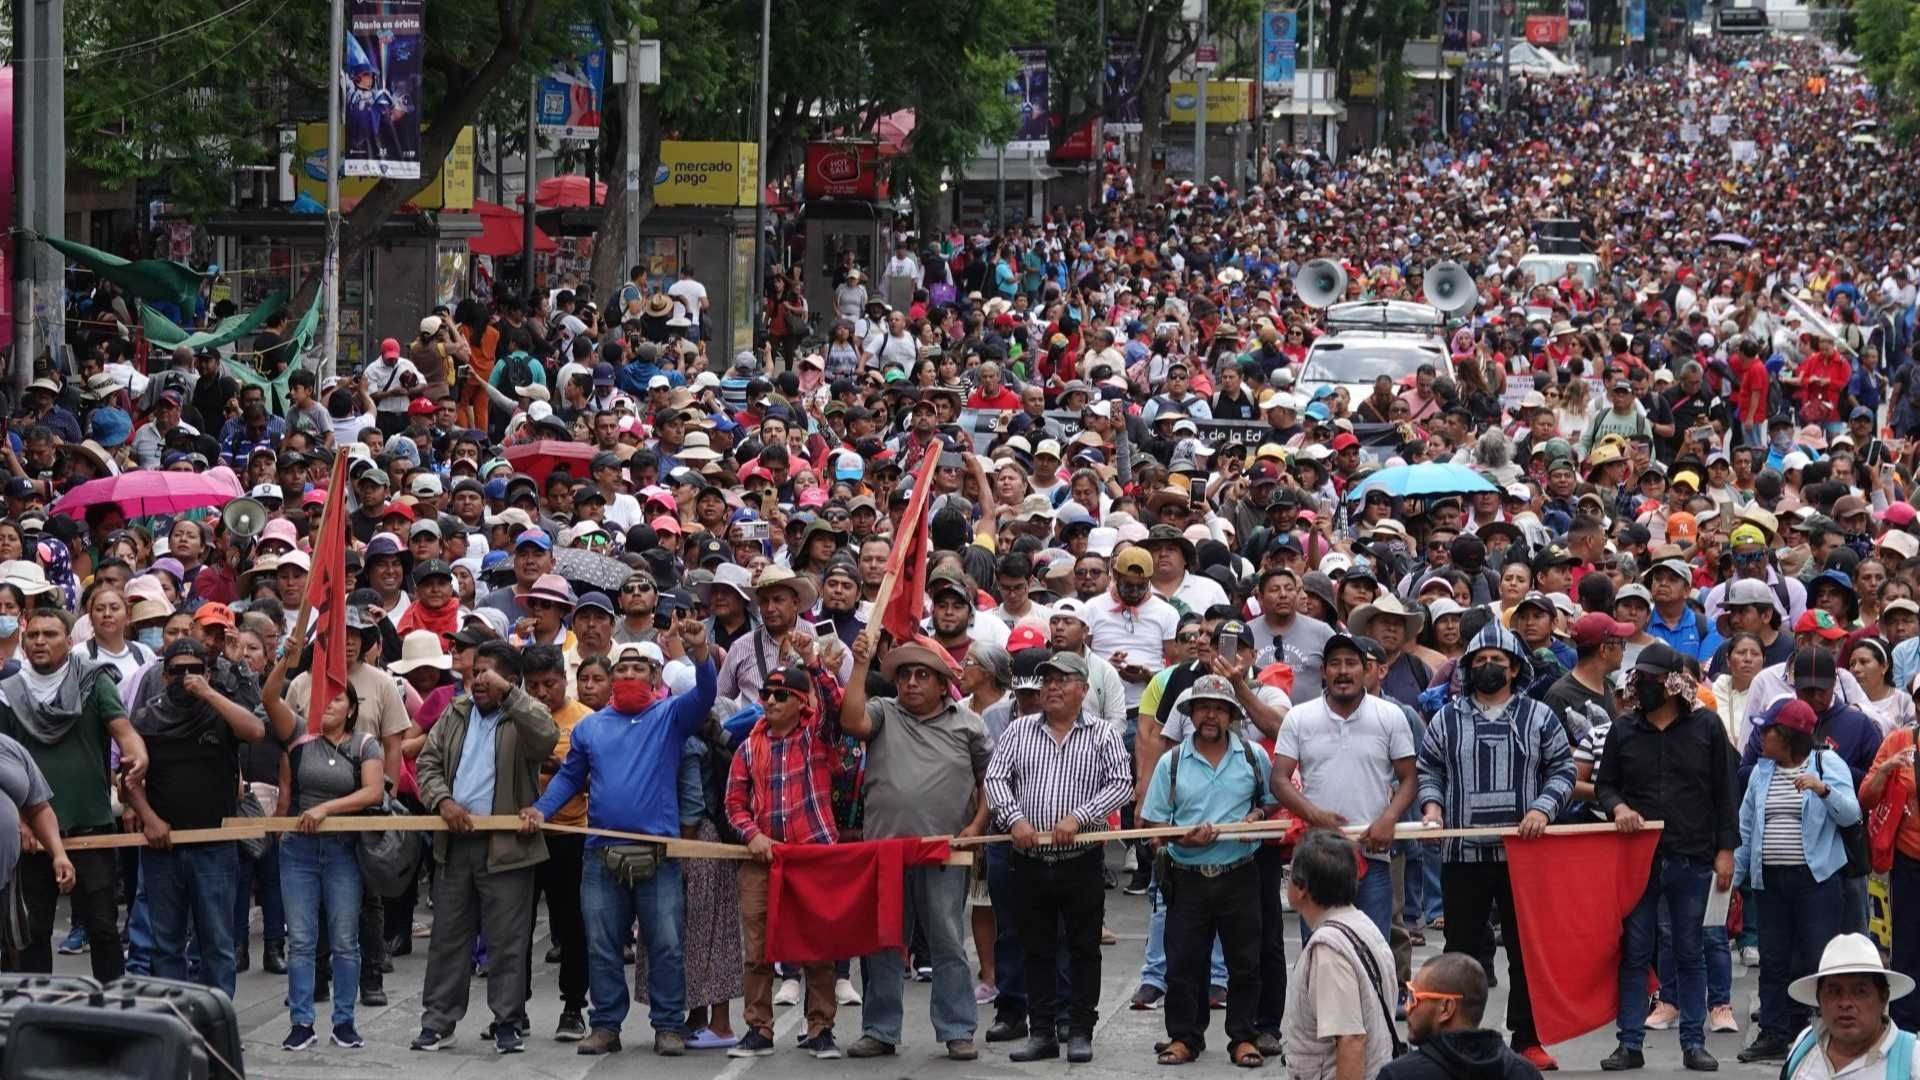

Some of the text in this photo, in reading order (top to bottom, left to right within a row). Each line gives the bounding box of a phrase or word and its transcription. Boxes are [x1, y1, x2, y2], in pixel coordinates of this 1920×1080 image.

[353, 20, 380, 30] Abuelo
[394, 19, 420, 29] órbita
[674, 160, 733, 172] mercado
[830, 159, 848, 167] HOT
[674, 173, 708, 186] pago
[1209, 429, 1226, 441] de
[1229, 429, 1242, 442] la
